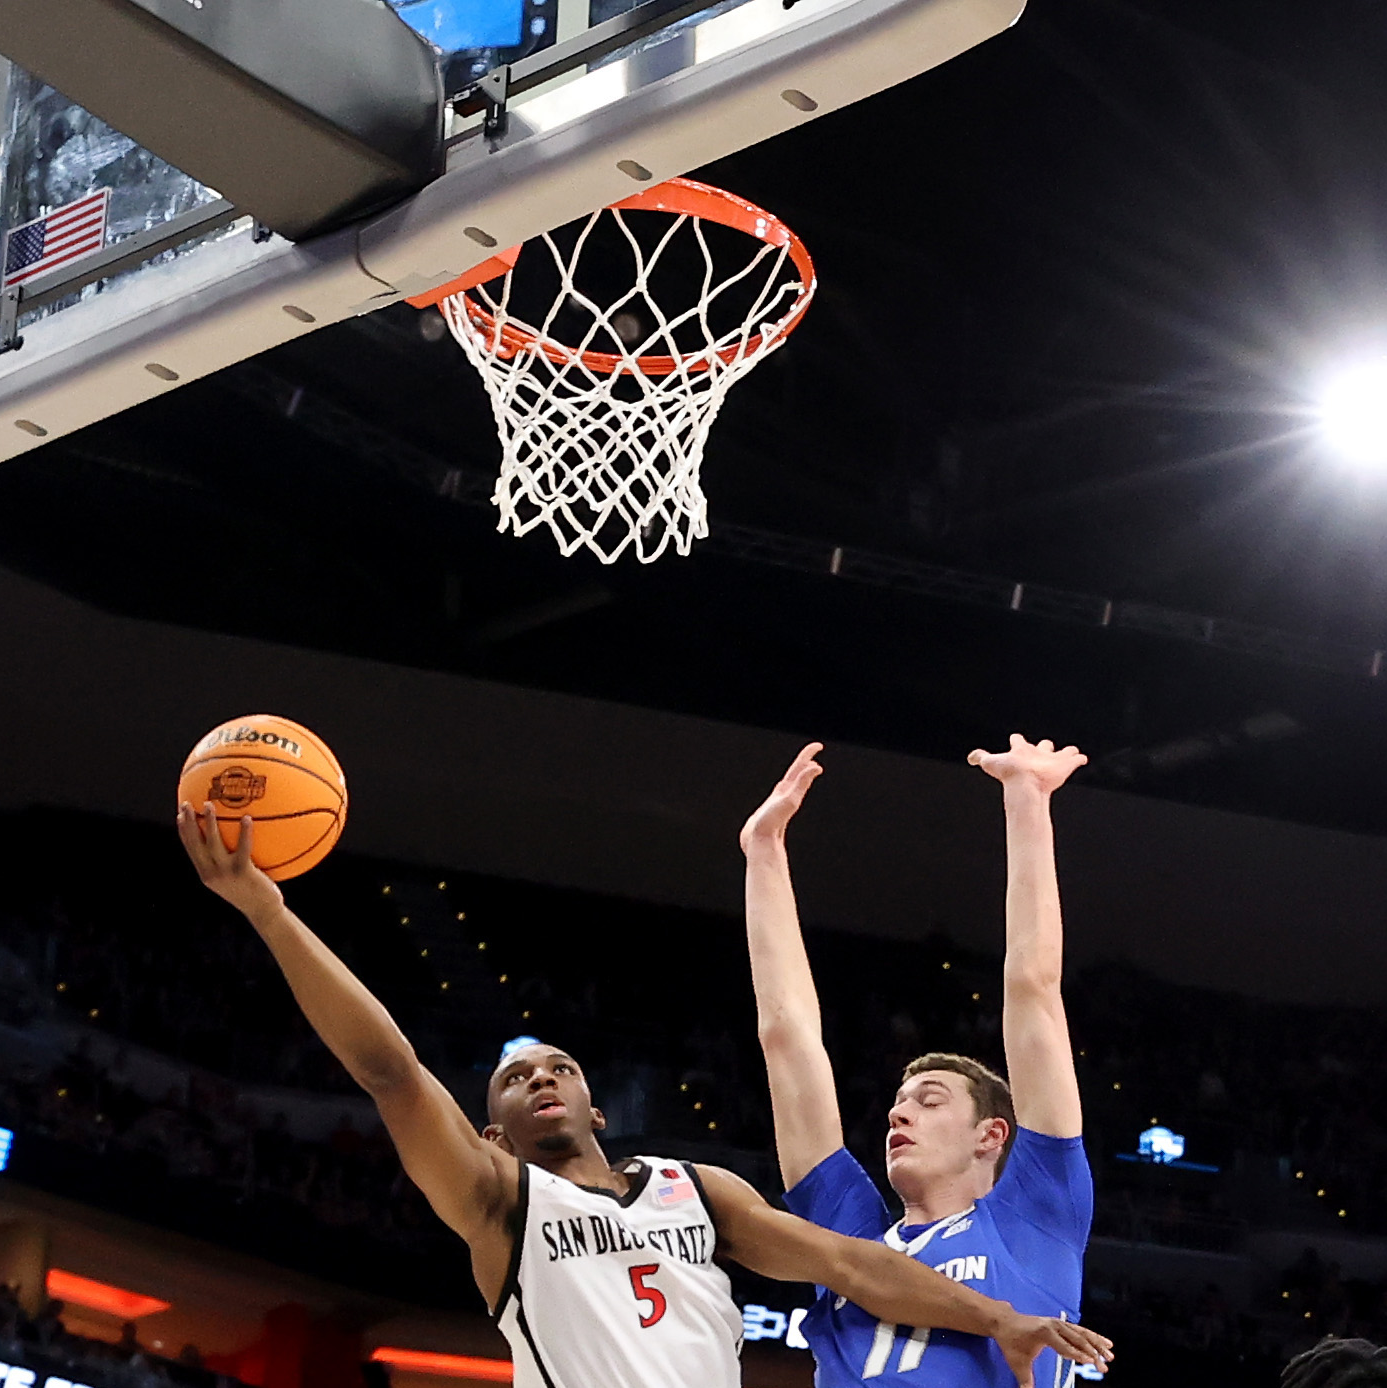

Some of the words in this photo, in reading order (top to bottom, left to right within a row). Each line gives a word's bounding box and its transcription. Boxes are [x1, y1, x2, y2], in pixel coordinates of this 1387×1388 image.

[542, 1216, 589, 1262] SAN
[647, 1224, 707, 1264] STATE
[629, 1263, 667, 1329] 5
